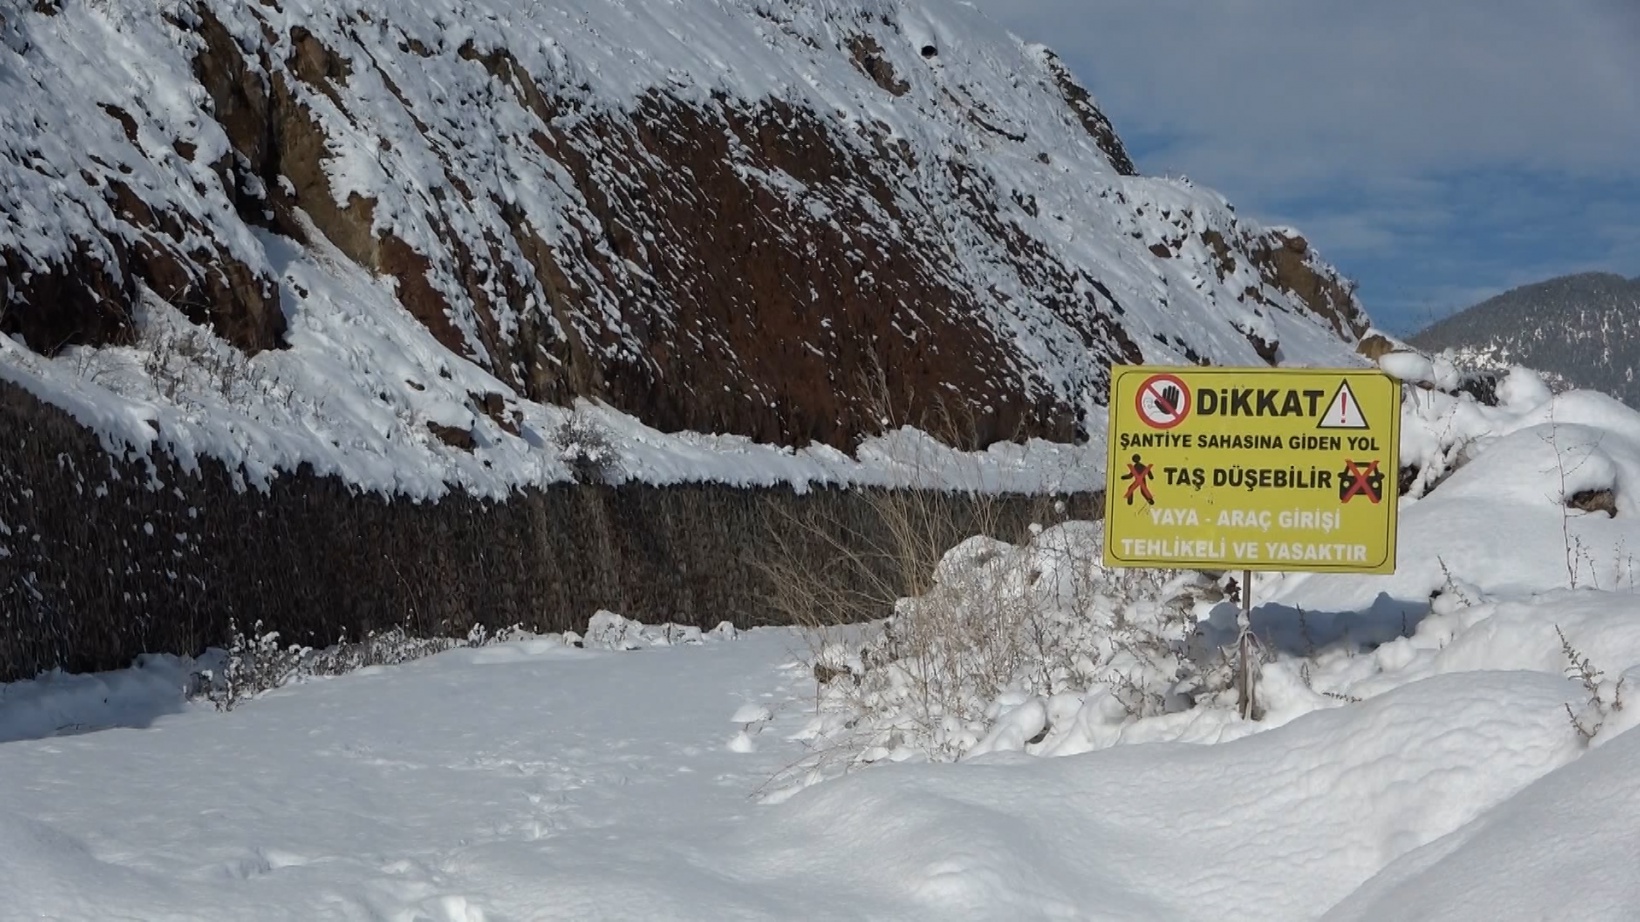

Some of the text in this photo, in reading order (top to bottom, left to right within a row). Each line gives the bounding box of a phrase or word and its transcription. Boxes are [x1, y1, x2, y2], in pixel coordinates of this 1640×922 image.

[1120, 432, 1380, 451] ŞANTİYE SAHASINA GİDEN YOL
[1163, 465, 1332, 492] TAŞ DÜŞEBİLİR
[1150, 508, 1199, 526] YAYA
[1217, 510, 1272, 532] ARAÇ
[1278, 508, 1341, 533] GİRİŞİ
[1121, 536, 1367, 561] TEHLİKELİ VE YASAKTIR
